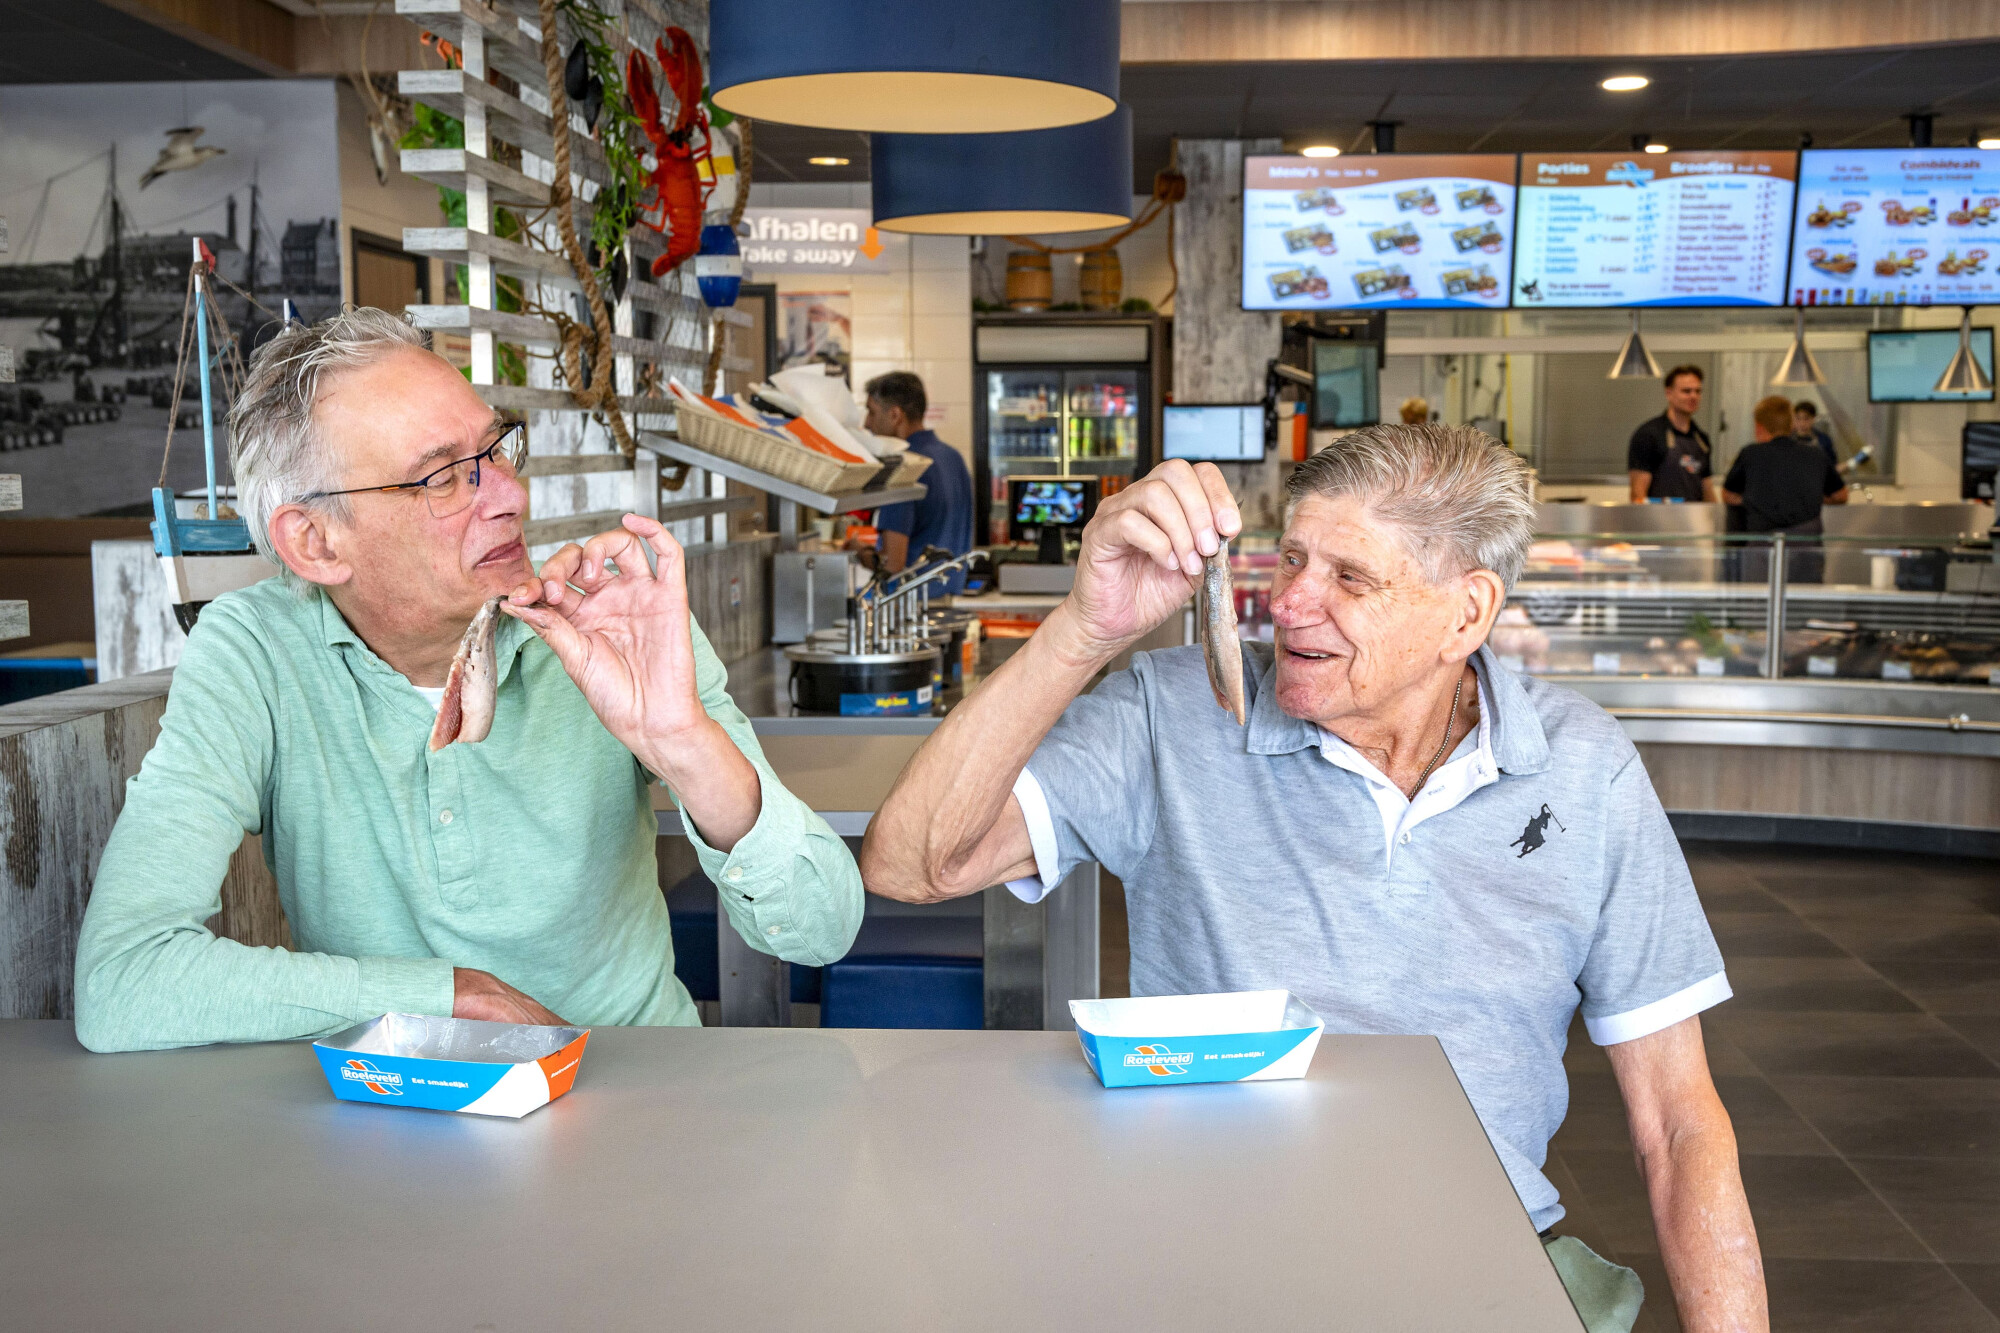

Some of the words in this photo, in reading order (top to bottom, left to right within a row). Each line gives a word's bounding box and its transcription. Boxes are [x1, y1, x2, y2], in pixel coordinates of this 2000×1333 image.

[1269, 166, 1319, 178] Menu's
[1538, 163, 1590, 175] Porties
[793, 249, 857, 267] away
[1126, 1054, 1190, 1065] Roeleveld
[343, 1069, 400, 1084] Roeleveld
[427, 1080, 470, 1089] smakelijk!
